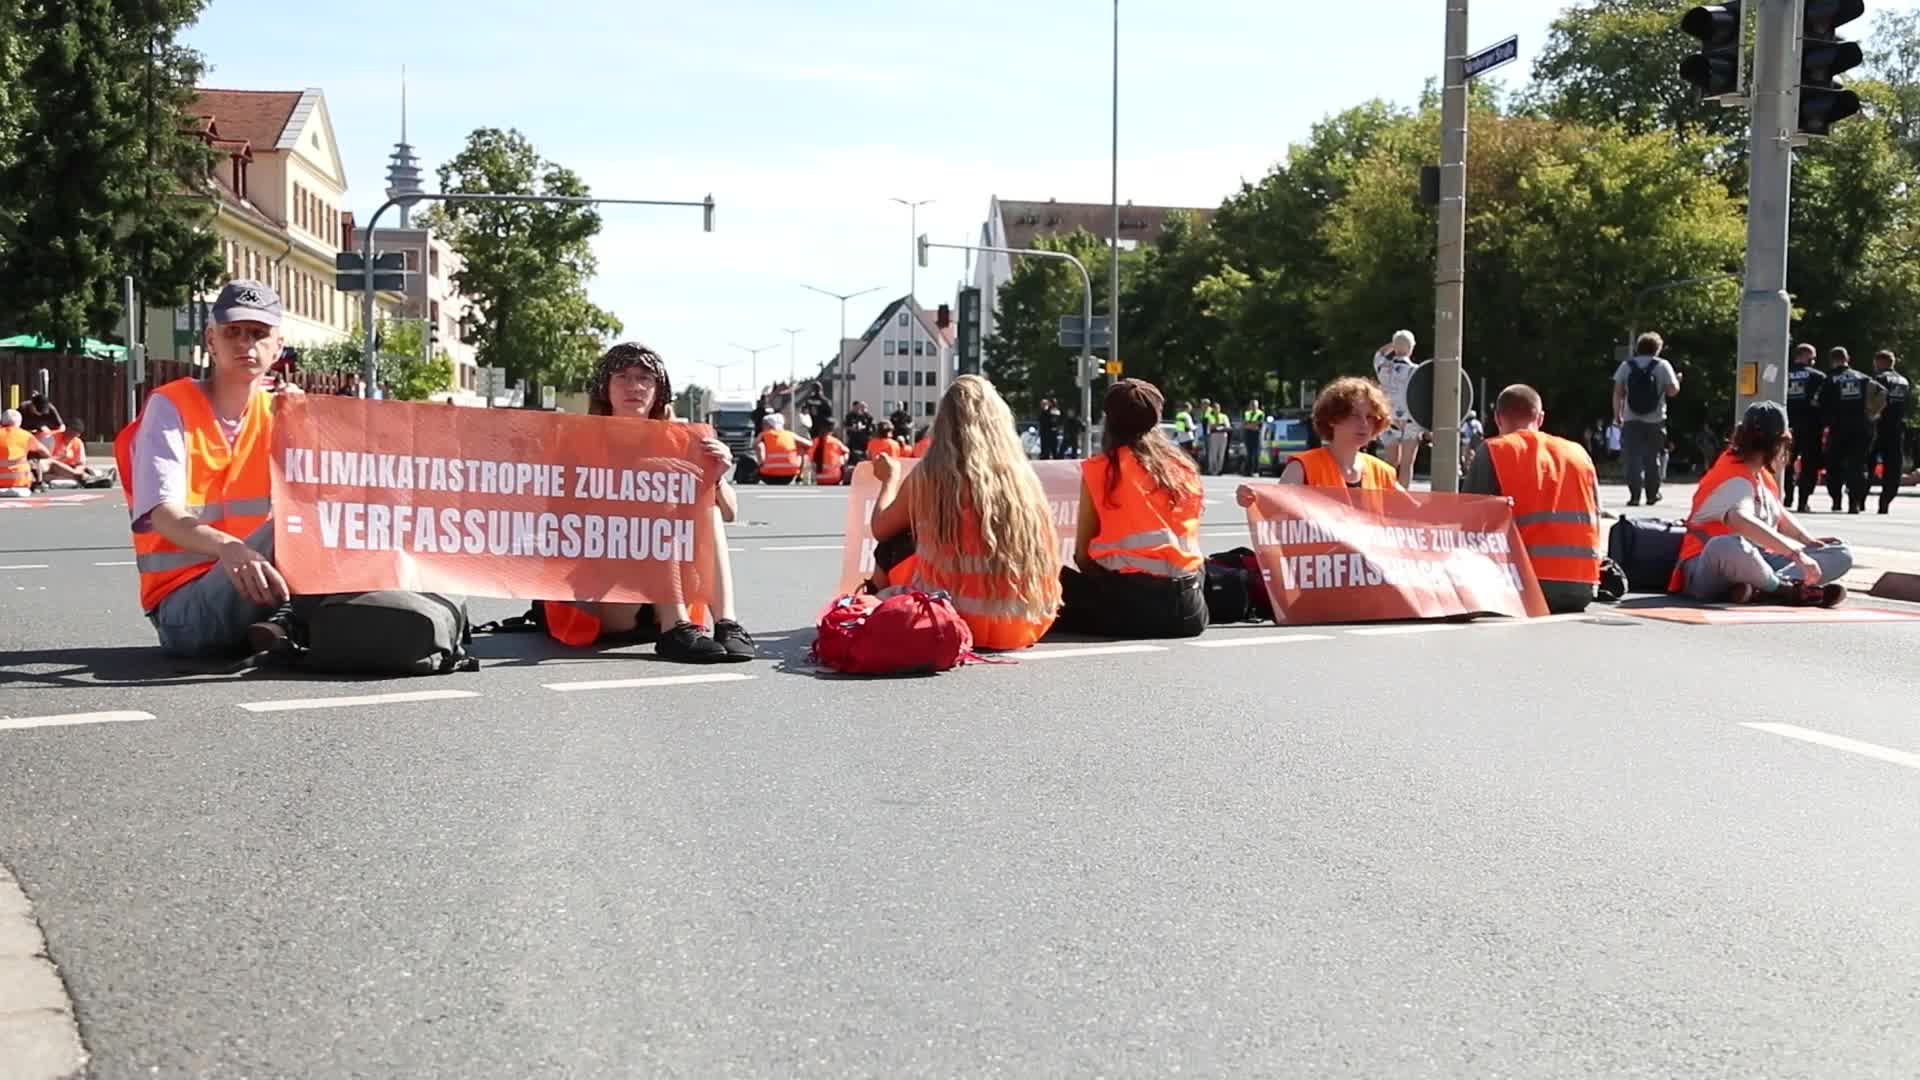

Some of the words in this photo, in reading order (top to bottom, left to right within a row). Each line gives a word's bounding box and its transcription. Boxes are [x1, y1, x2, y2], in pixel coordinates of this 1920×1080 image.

[285, 448, 565, 498] KLIMAKATASTROPHE
[574, 466, 696, 504] ZULASSEN
[317, 501, 695, 562] VERFASSUNGSBRUCH
[1430, 528, 1510, 553] ZULASSEN
